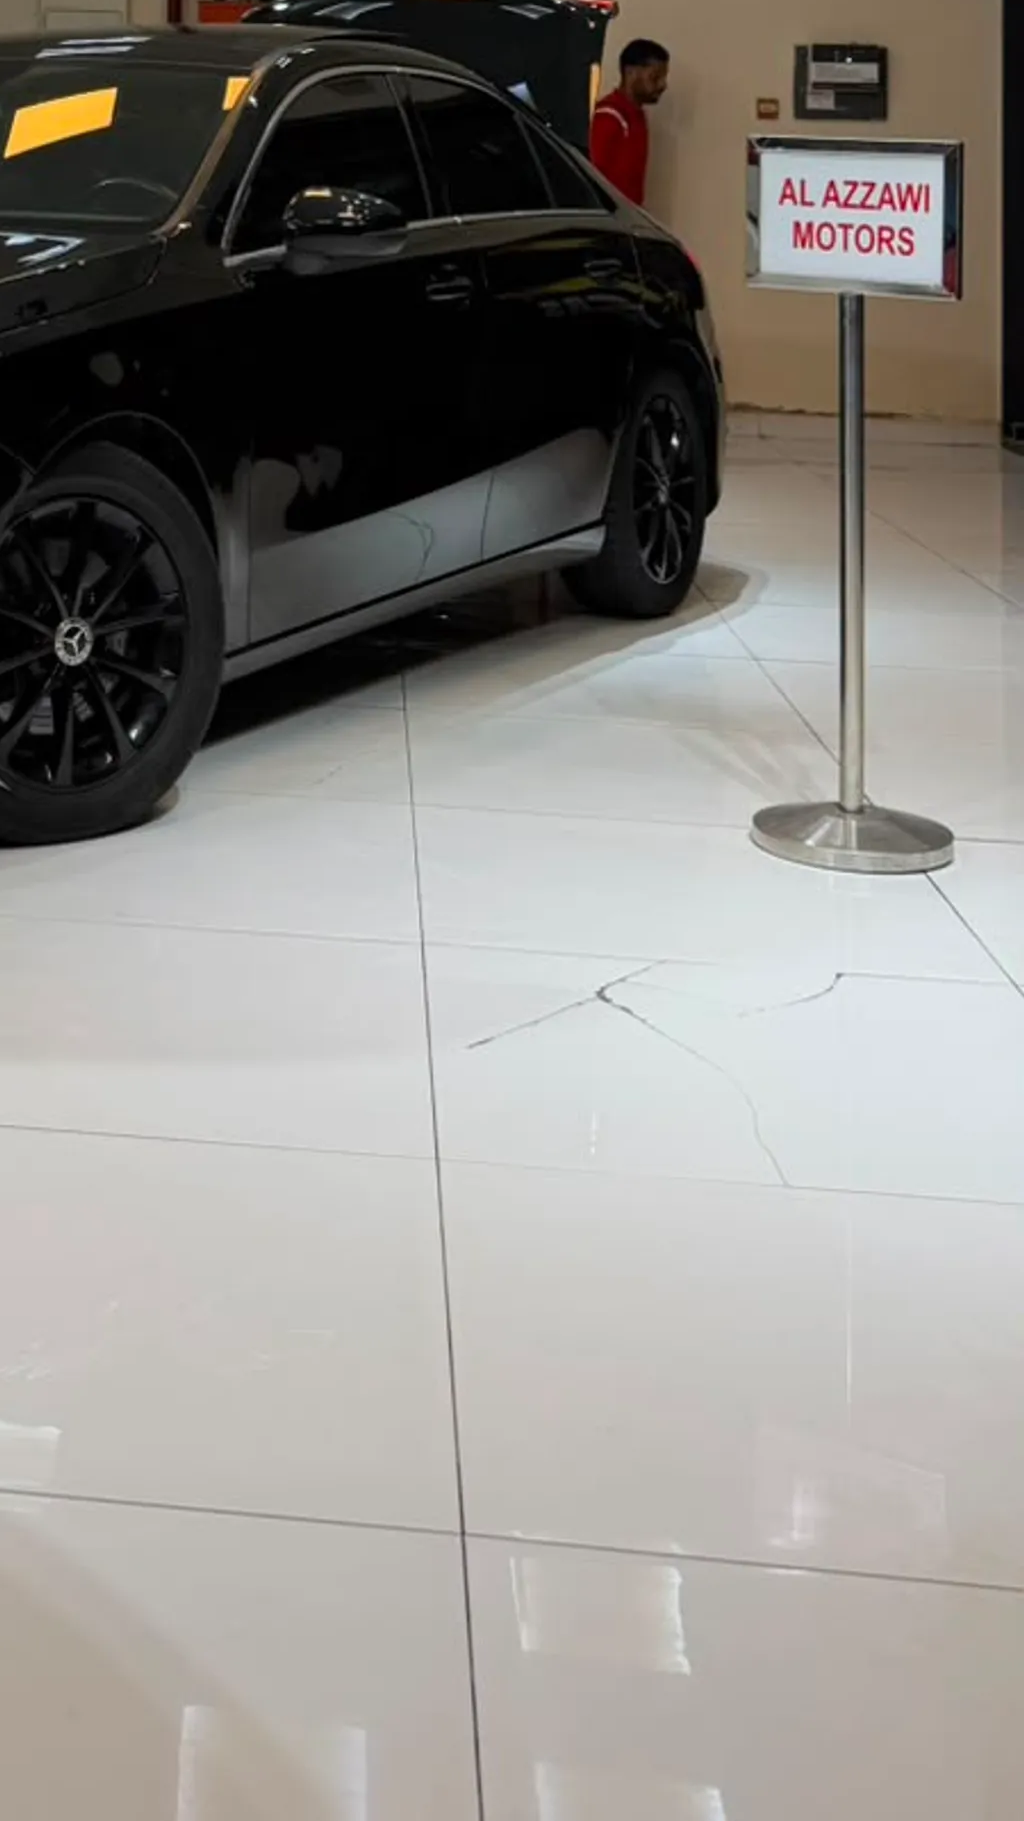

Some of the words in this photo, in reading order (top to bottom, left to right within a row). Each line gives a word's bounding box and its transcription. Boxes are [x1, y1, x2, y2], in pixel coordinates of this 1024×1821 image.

[778, 177, 815, 207] AL
[822, 179, 932, 214] AZZAWI
[792, 220, 916, 257] MOTORS
